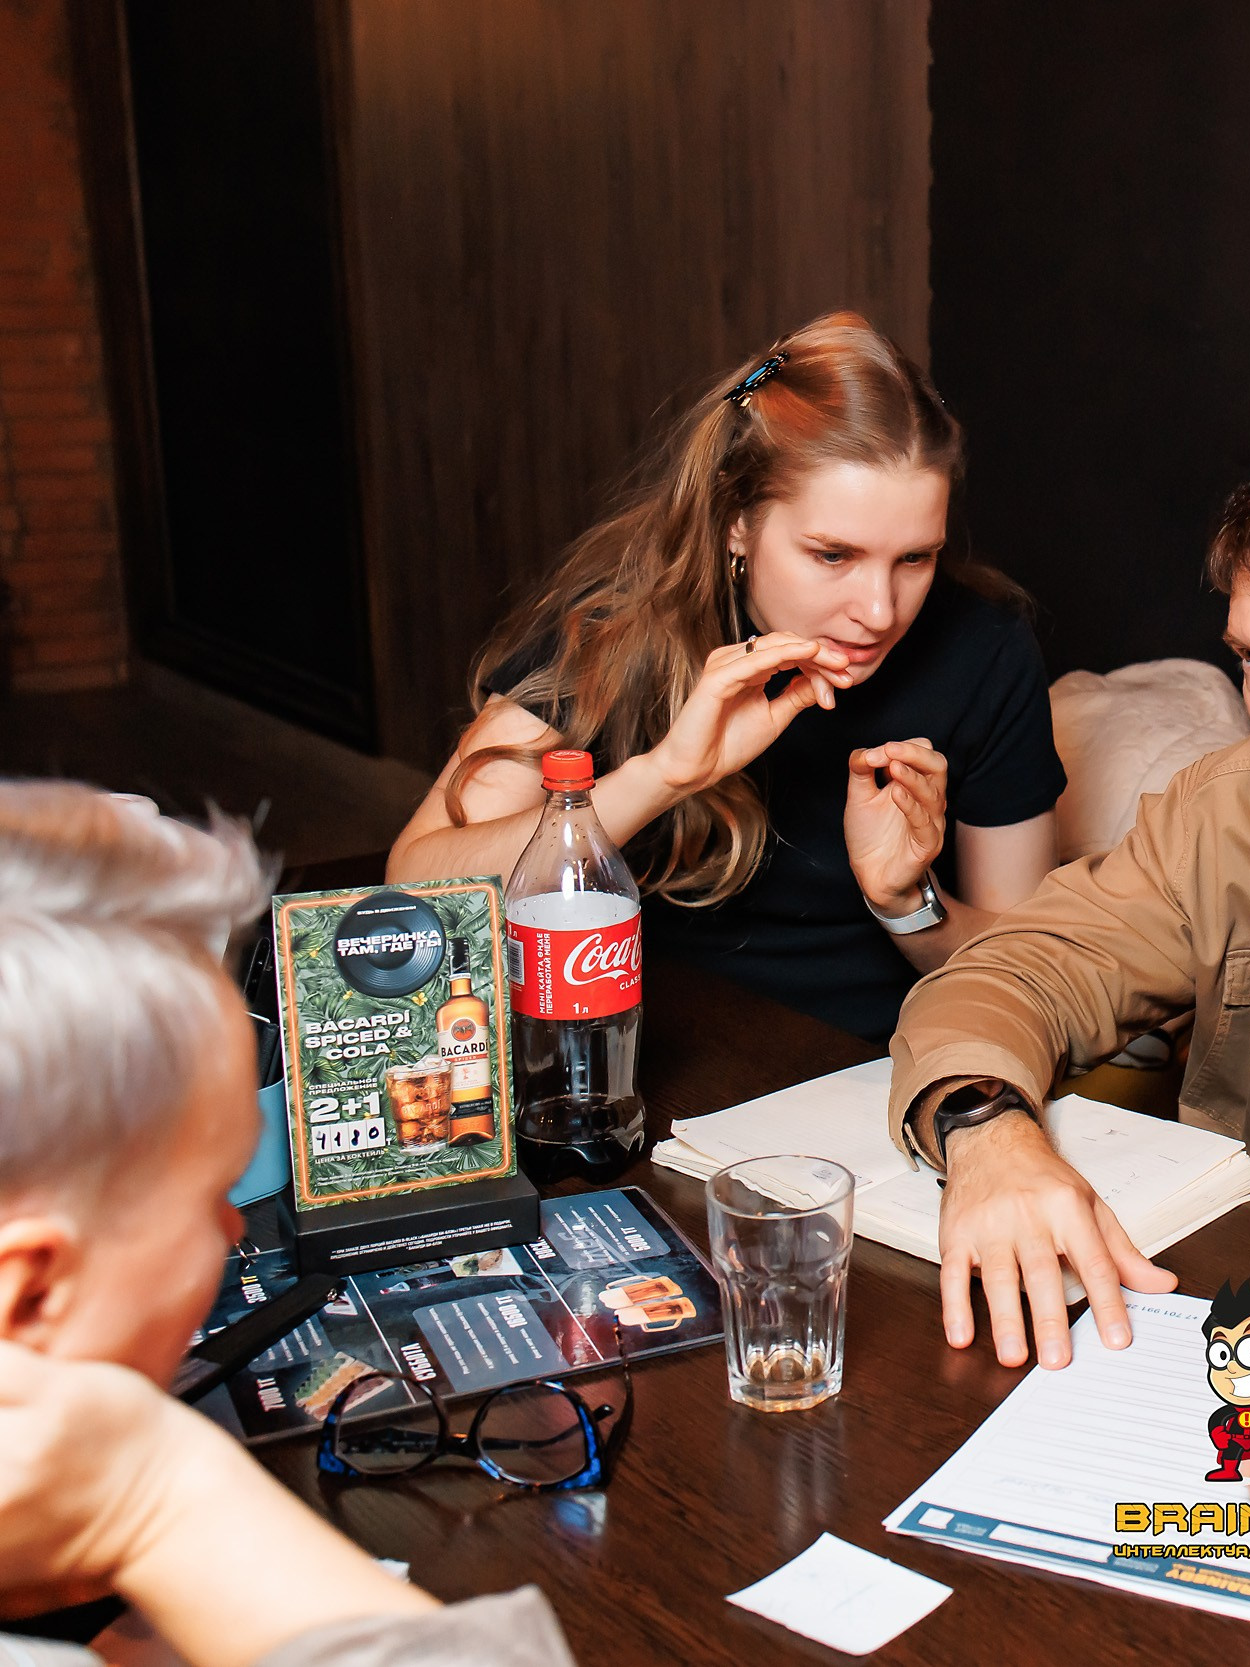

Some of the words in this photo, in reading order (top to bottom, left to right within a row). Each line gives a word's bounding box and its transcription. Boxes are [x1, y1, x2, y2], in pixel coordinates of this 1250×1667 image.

[507, 923, 513, 935] 1
[337, 930, 441, 948] ВЕЧЕРИНКА
[381, 940, 414, 953] ГДЕ
[416, 937, 442, 948] ТЫ
[543, 933, 551, 956] МЕНЯ
[544, 959, 553, 1014] ПЕРЕРАБОТАЙ
[572, 1002, 580, 1015] 1
[305, 1028, 391, 1049] SPICED
[395, 1026, 413, 1038] &
[325, 1042, 391, 1061] COLA
[308, 1077, 378, 1091] СПЕЦИАЛЬНОЕ
[308, 1082, 378, 1096] ПРЕДЛОЖЕНИЕ
[315, 1156, 336, 1165] ЦЕНА
[336, 1154, 346, 1162] ЗА
[346, 1149, 385, 1161] КОКТЕЙЛЬ
[624, 1233, 651, 1252] 5000
[241, 1283, 267, 1304] 3500
[498, 1304, 528, 1329] 16500
[1163, 1310, 1182, 1318] 701
[400, 1342, 437, 1382] СУББОТА
[257, 1386, 287, 1412] 7000
